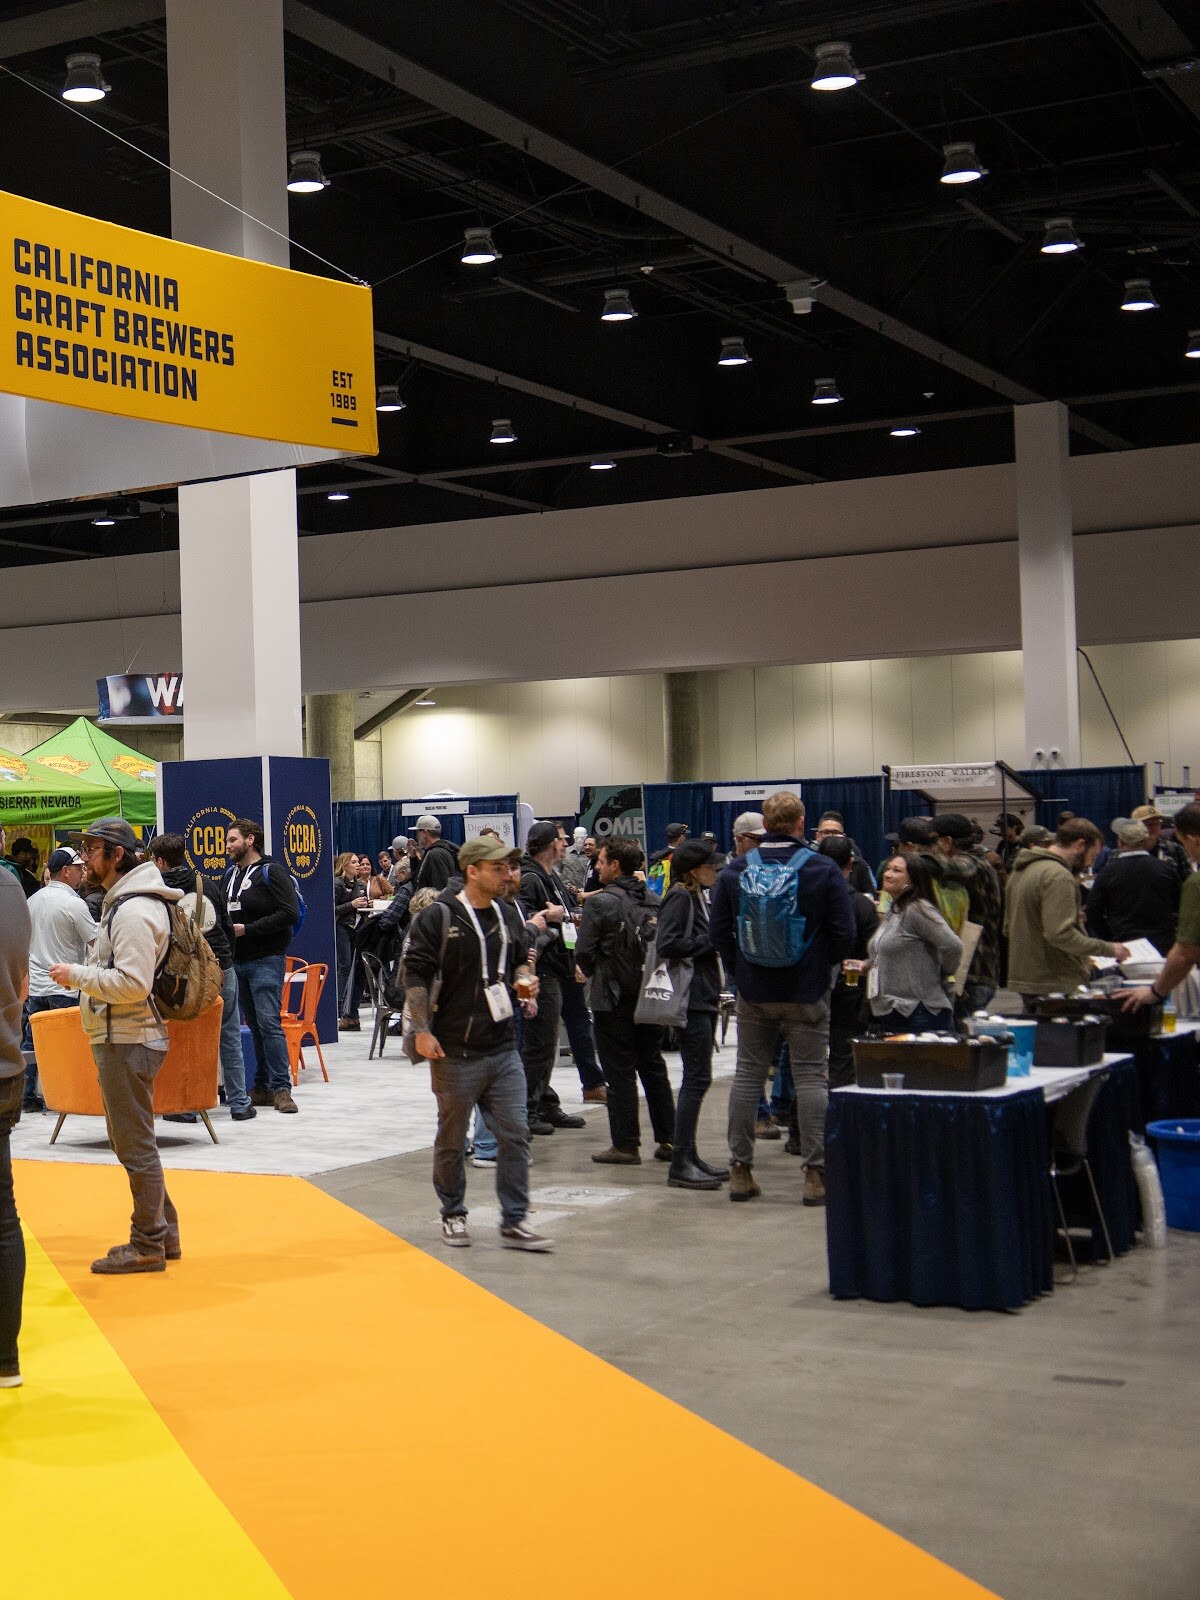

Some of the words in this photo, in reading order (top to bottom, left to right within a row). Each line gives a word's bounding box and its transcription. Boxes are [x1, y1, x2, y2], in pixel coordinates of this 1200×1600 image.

[14, 238, 179, 312] CALIFORNIA
[15, 285, 105, 338] CRAFT
[114, 309, 234, 366] BREWERS
[16, 332, 198, 401] ASSOCIATION
[332, 370, 353, 390] EST
[330, 392, 357, 411] 1989
[896, 770, 946, 778] FIRESTONE
[40, 795, 82, 810] NEVADA
[184, 806, 218, 838] CALIFORNIA
[284, 805, 304, 835] CALIFORNIA
[193, 826, 230, 856] CCB
[289, 824, 316, 853] CCBA
